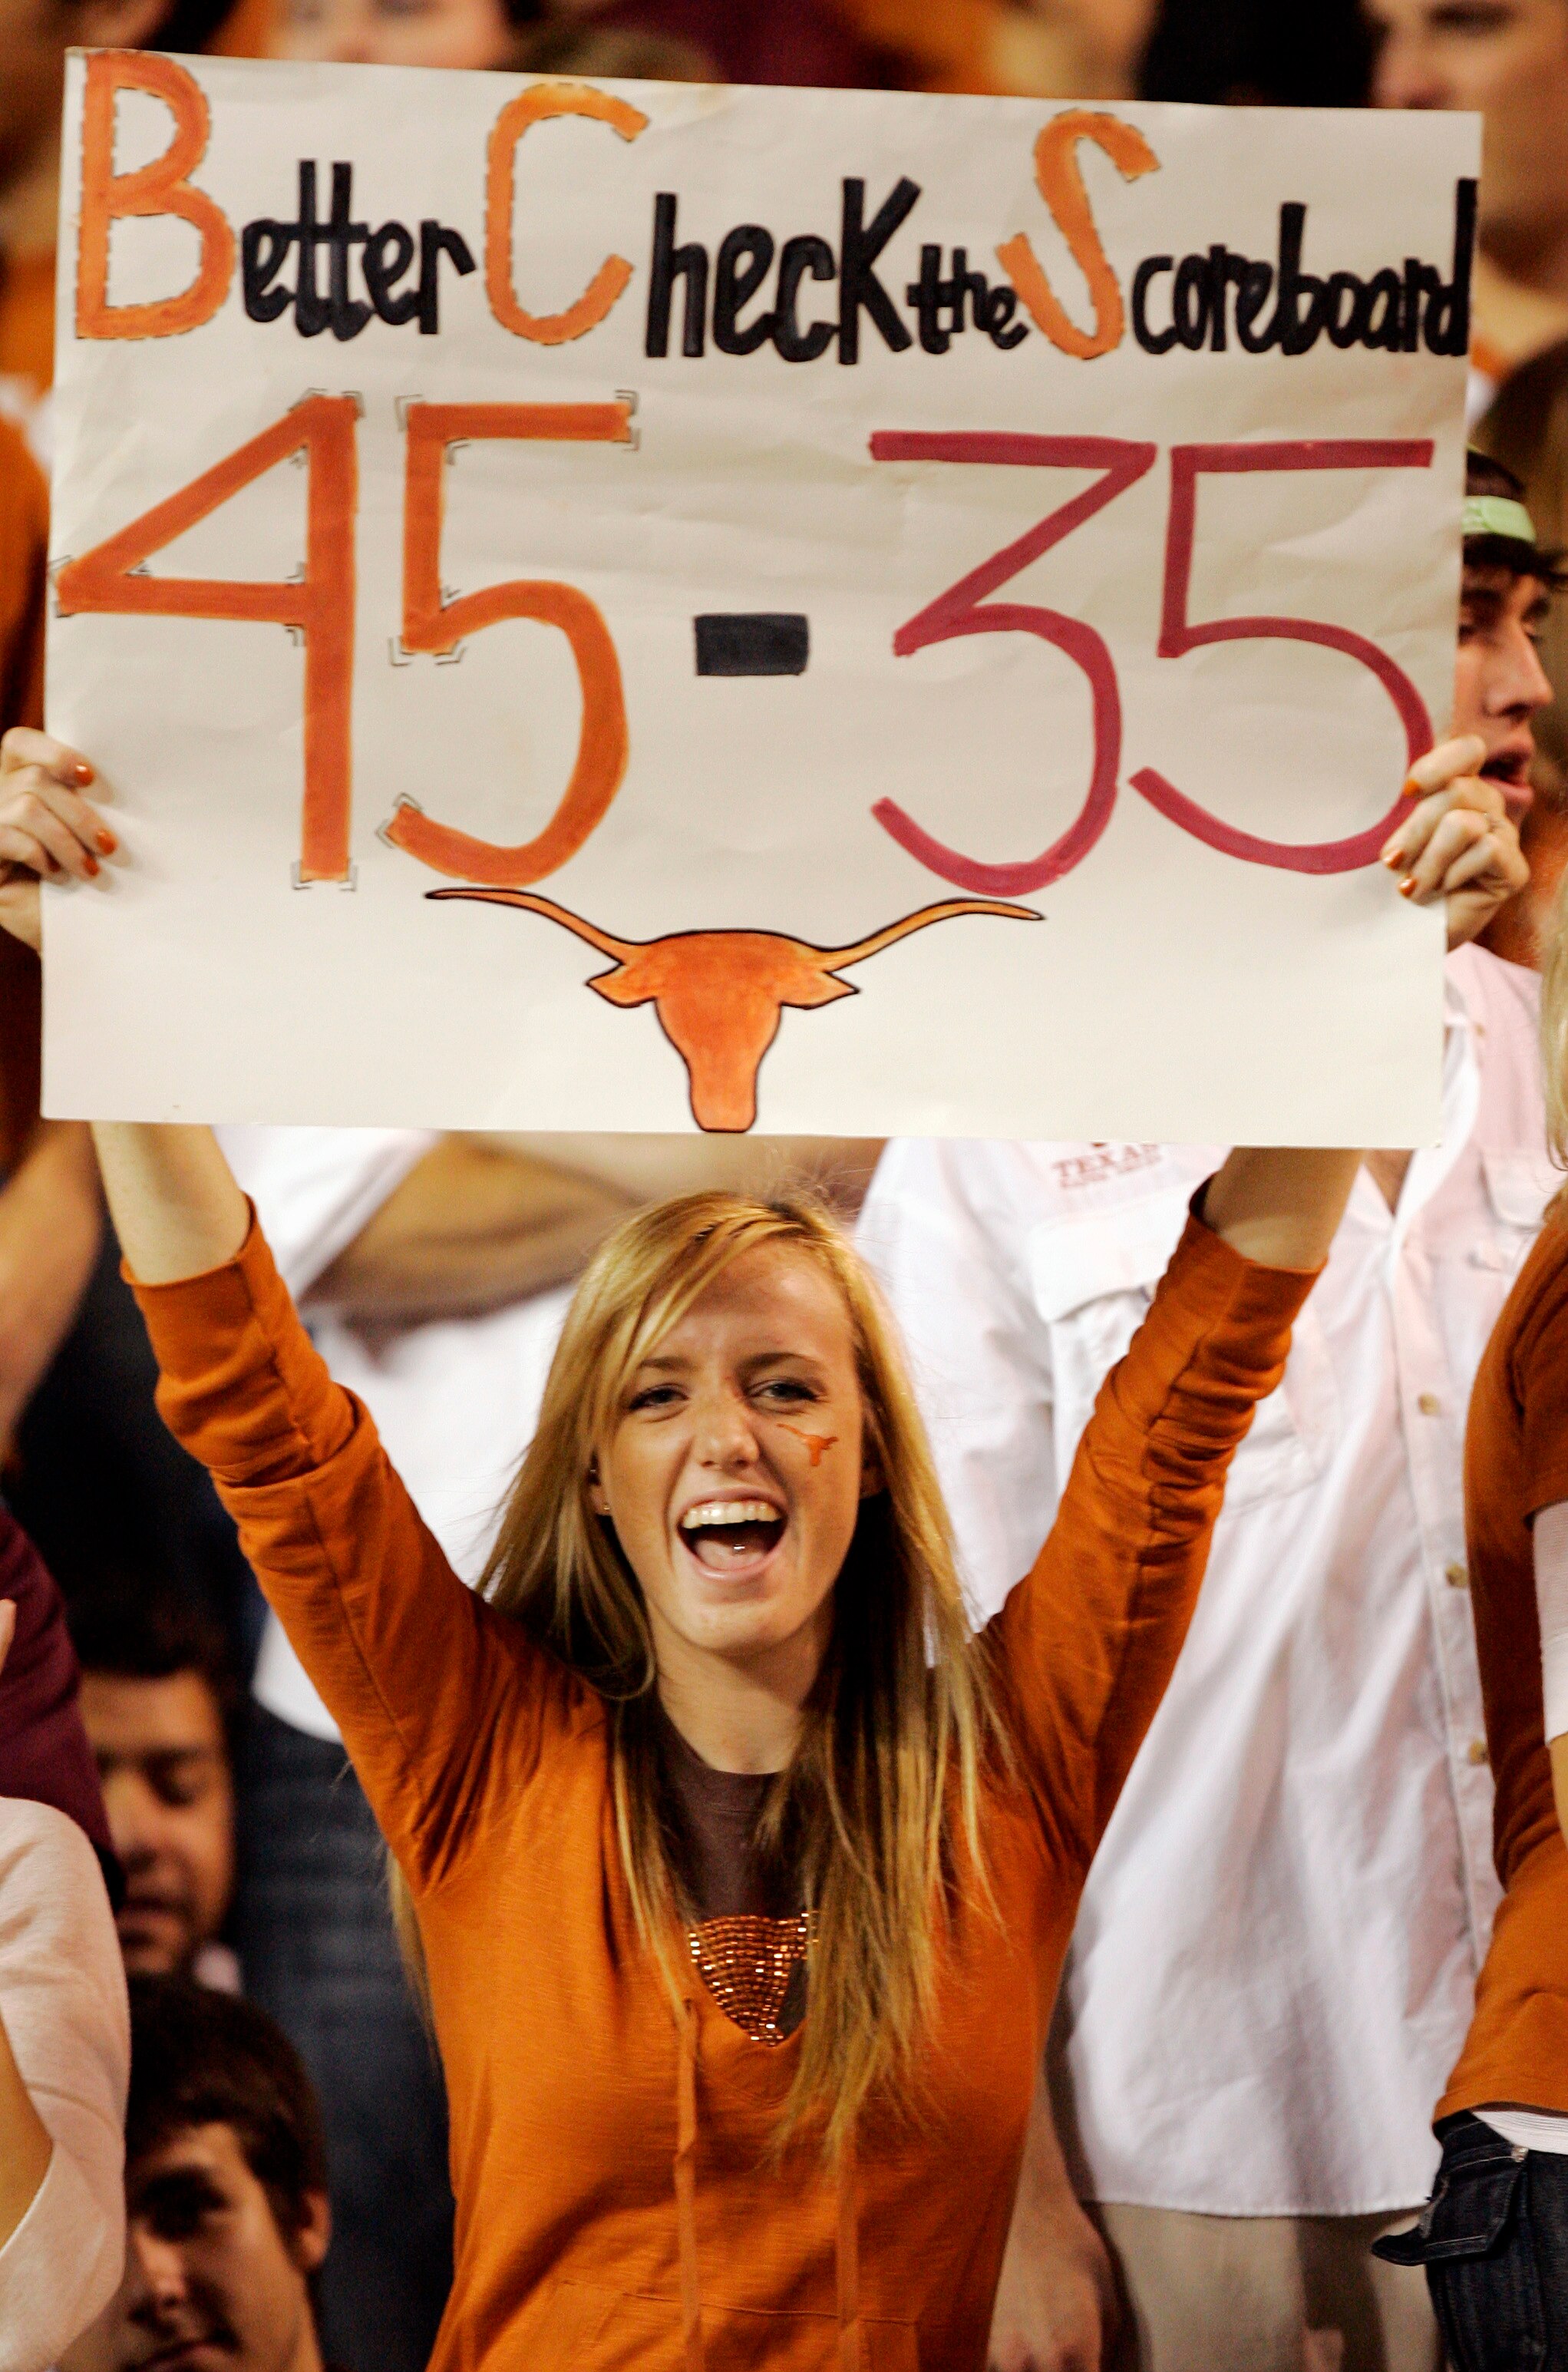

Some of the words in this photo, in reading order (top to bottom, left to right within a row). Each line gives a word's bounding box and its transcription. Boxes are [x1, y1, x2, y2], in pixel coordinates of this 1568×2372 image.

[76, 51, 476, 342] Better
[907, 244, 1028, 355] the
[995, 107, 1478, 361] Scoreboard
